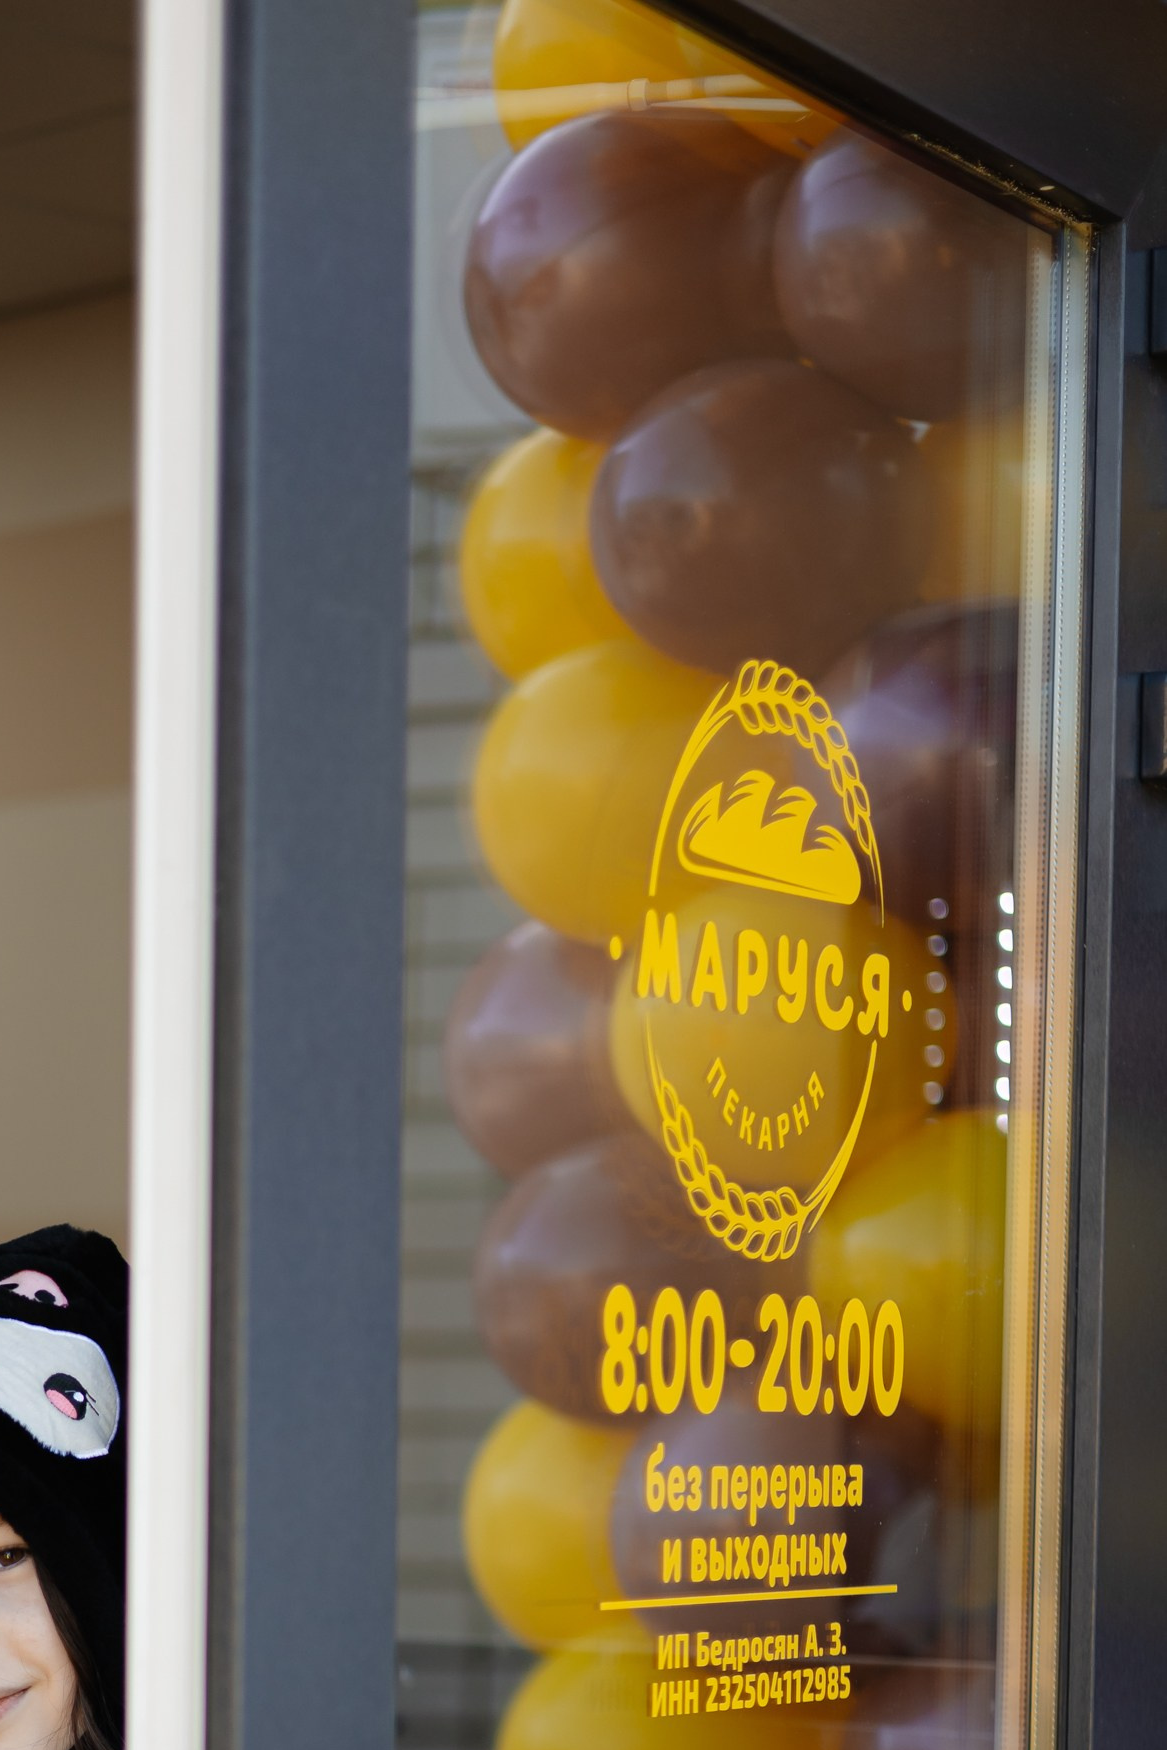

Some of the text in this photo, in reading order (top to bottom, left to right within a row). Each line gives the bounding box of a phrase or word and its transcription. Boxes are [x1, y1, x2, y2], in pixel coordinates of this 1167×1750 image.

[636, 908, 890, 1039] МАРУСЯ
[706, 1057, 826, 1151] ПЕКАРНЯ
[646, 1442, 864, 1526] без перерыва
[662, 1532, 847, 1587] и выходных
[657, 1633, 690, 1670] ИП
[696, 1631, 799, 1672] Бедросян
[651, 1665, 851, 1718] ИНН 232504112985
